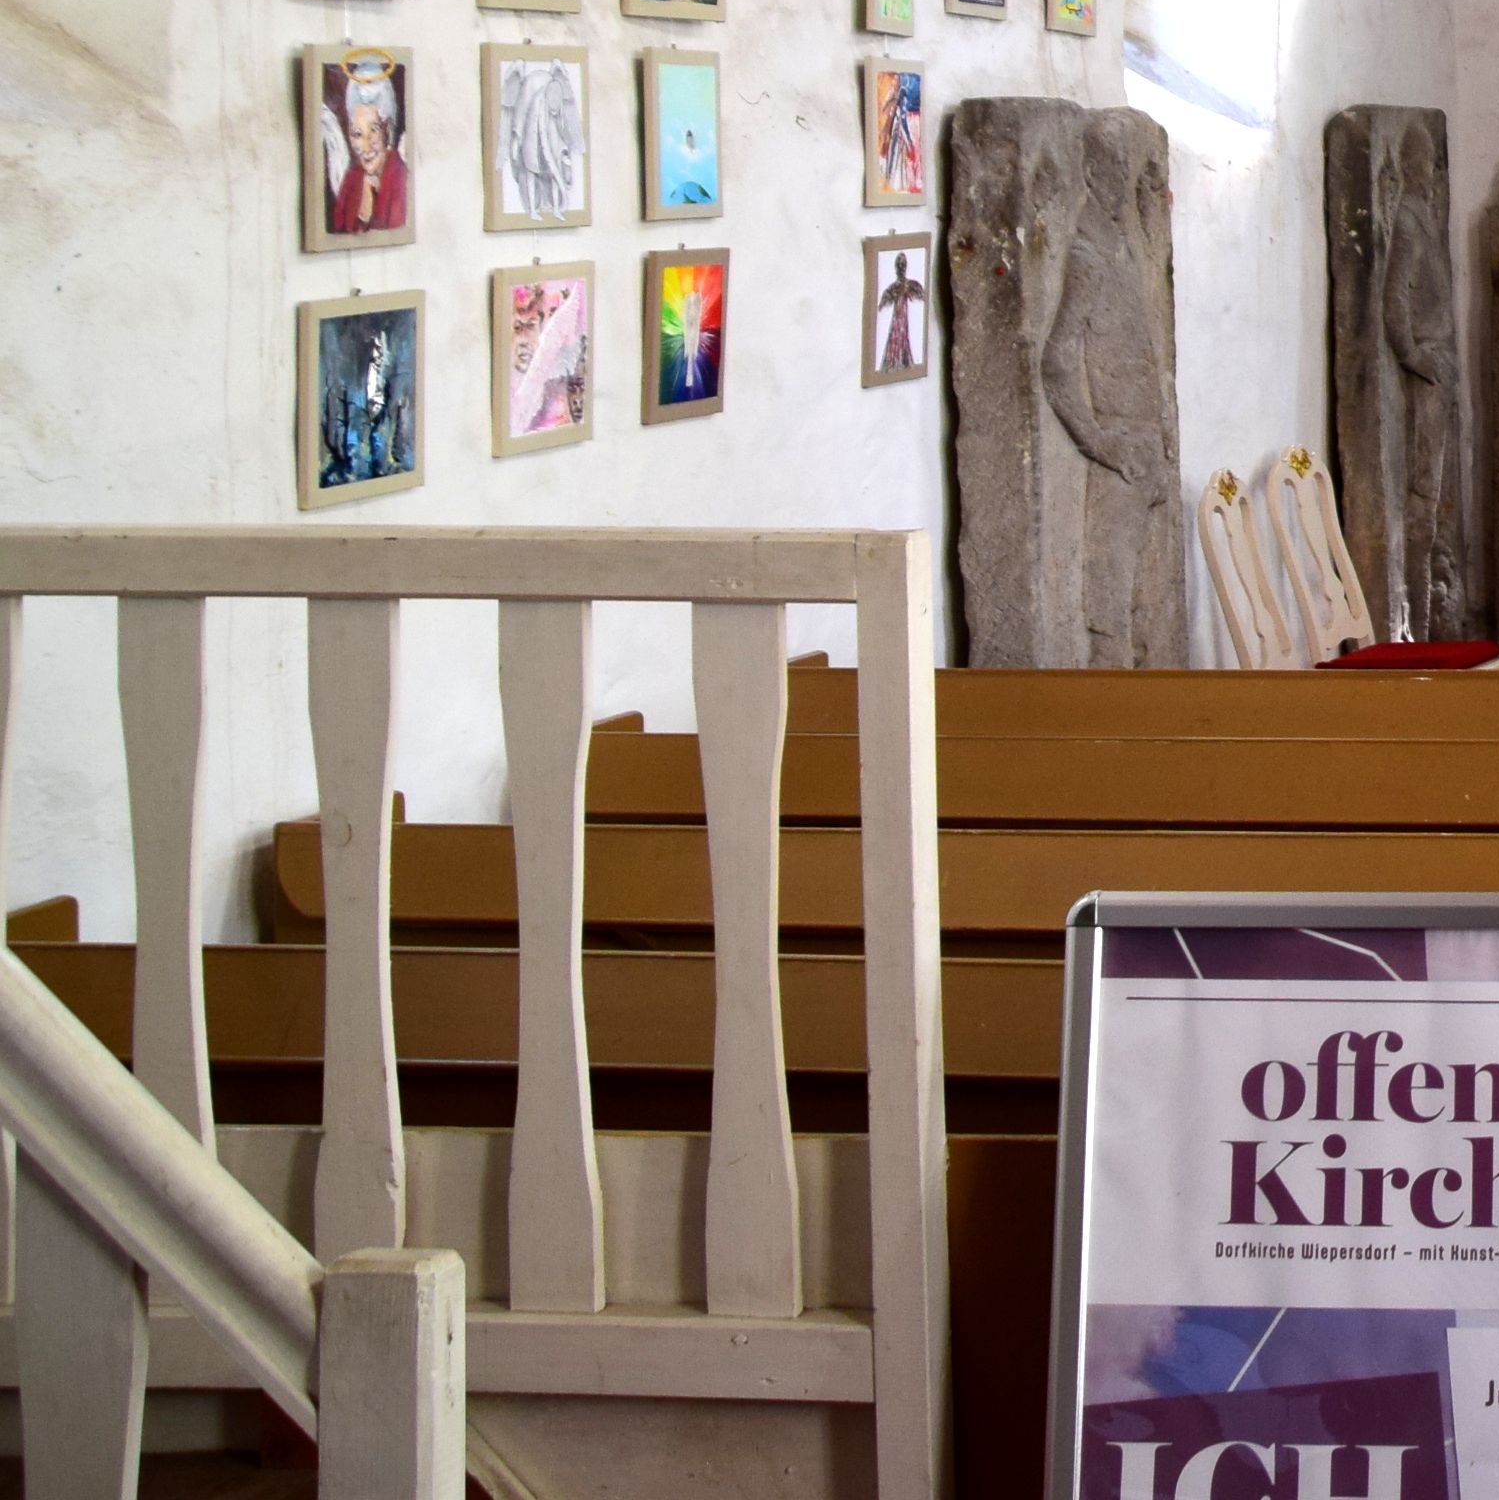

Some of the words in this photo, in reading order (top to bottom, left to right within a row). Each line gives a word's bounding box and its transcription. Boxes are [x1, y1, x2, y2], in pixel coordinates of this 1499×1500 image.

[1215, 1241, 1295, 1260] Dorfkirche
[1301, 1243, 1397, 1263] Wiepersdorf
[1419, 1244, 1445, 1262] mit
